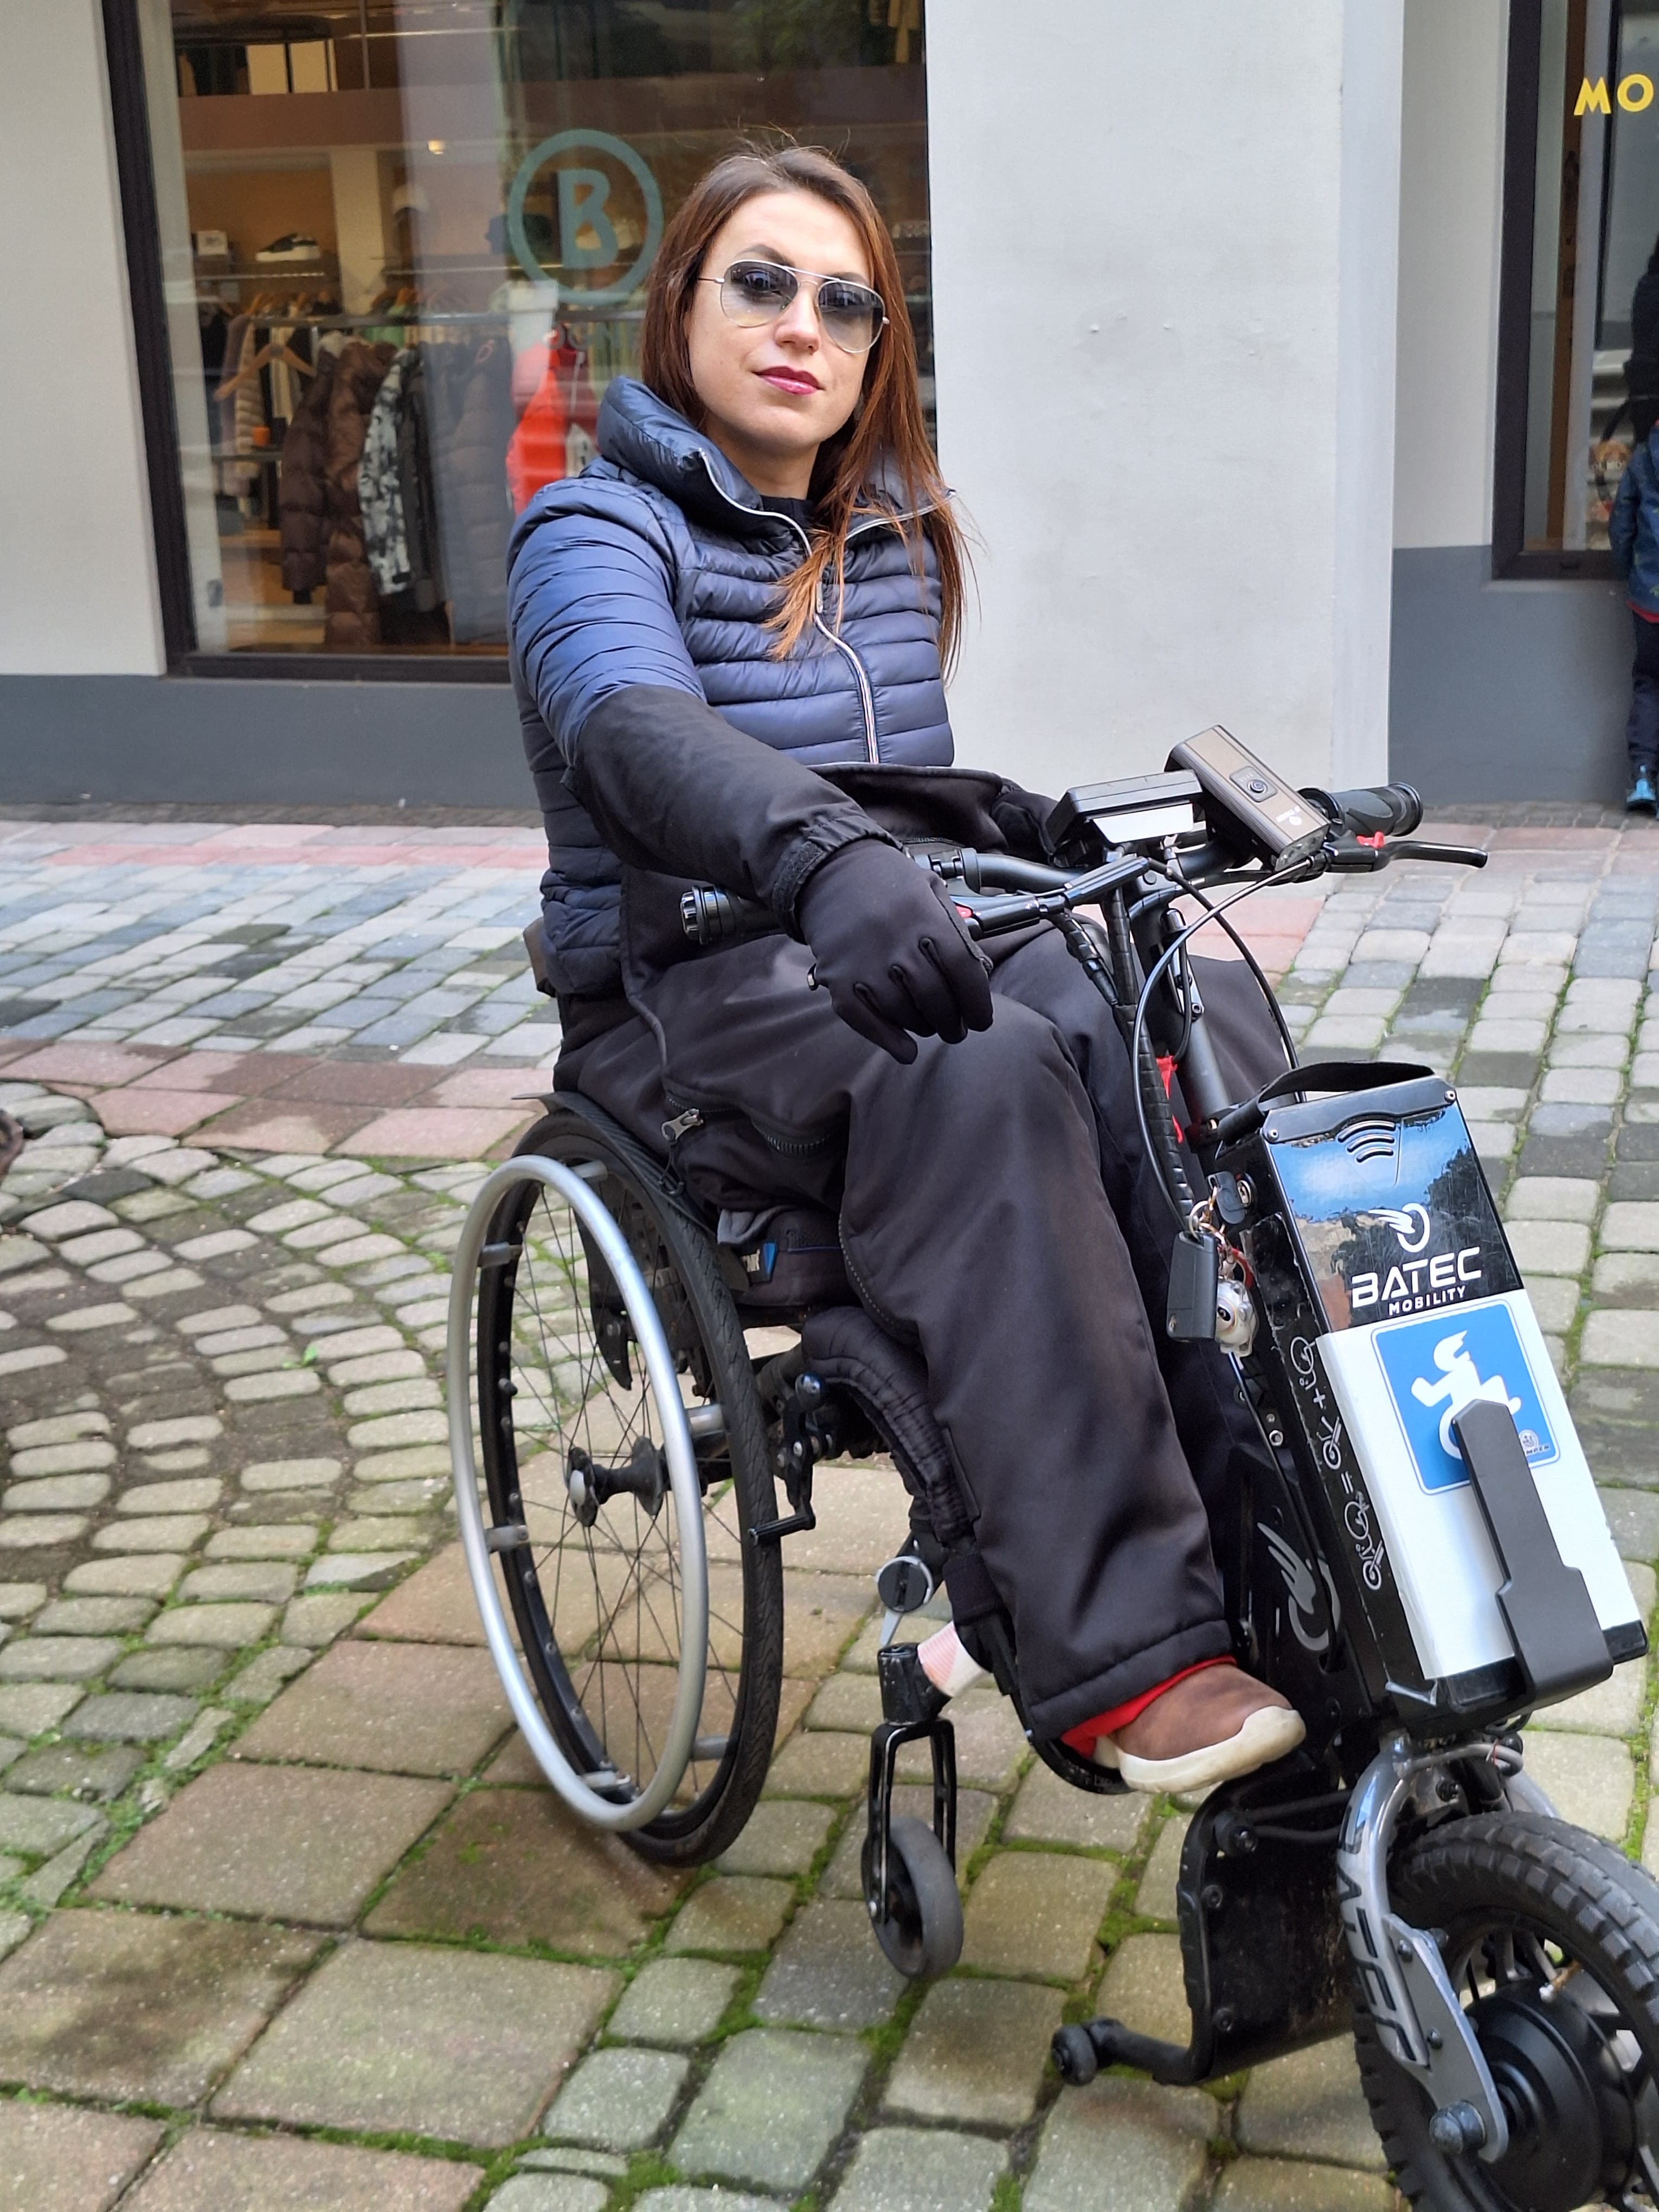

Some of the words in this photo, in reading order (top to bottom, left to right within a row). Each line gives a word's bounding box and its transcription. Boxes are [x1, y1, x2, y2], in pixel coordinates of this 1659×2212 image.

[1573, 73, 1654, 116] MO
[557, 168, 619, 269] B
[1351, 1246, 1482, 1308] BATEC
[1388, 1285, 1466, 1316] MOBILITY
